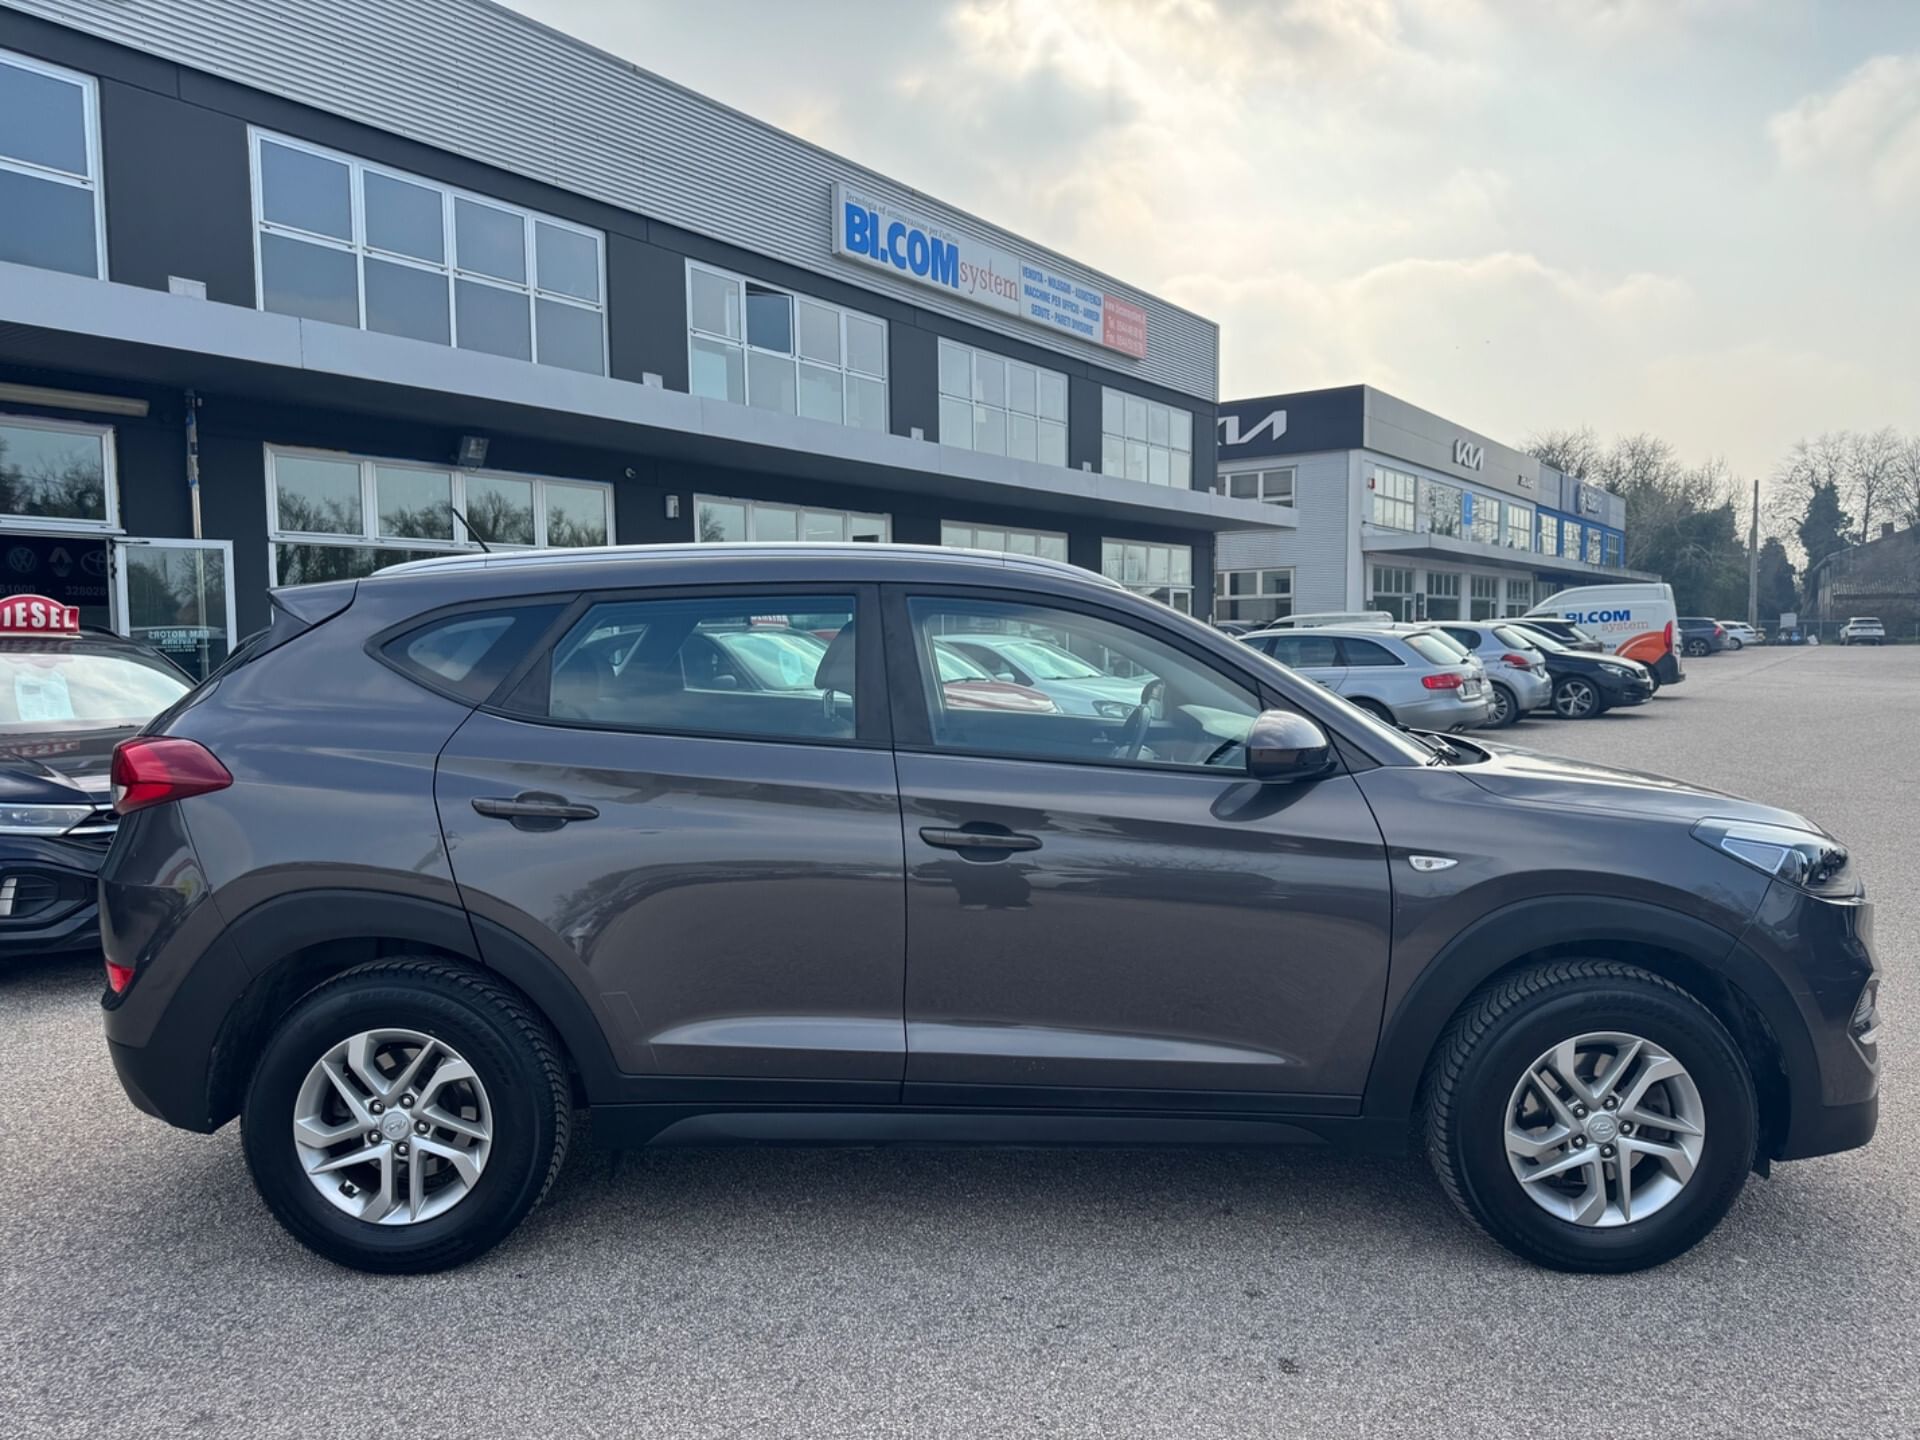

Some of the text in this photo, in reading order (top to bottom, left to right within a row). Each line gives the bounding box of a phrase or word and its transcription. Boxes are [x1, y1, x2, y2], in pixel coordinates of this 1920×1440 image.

[845, 202, 1019, 301] BI.COM system
[1022, 265, 1043, 284] VENDITA
[1453, 439, 1484, 471] KIA
[1566, 610, 1649, 632] BI.COM system
